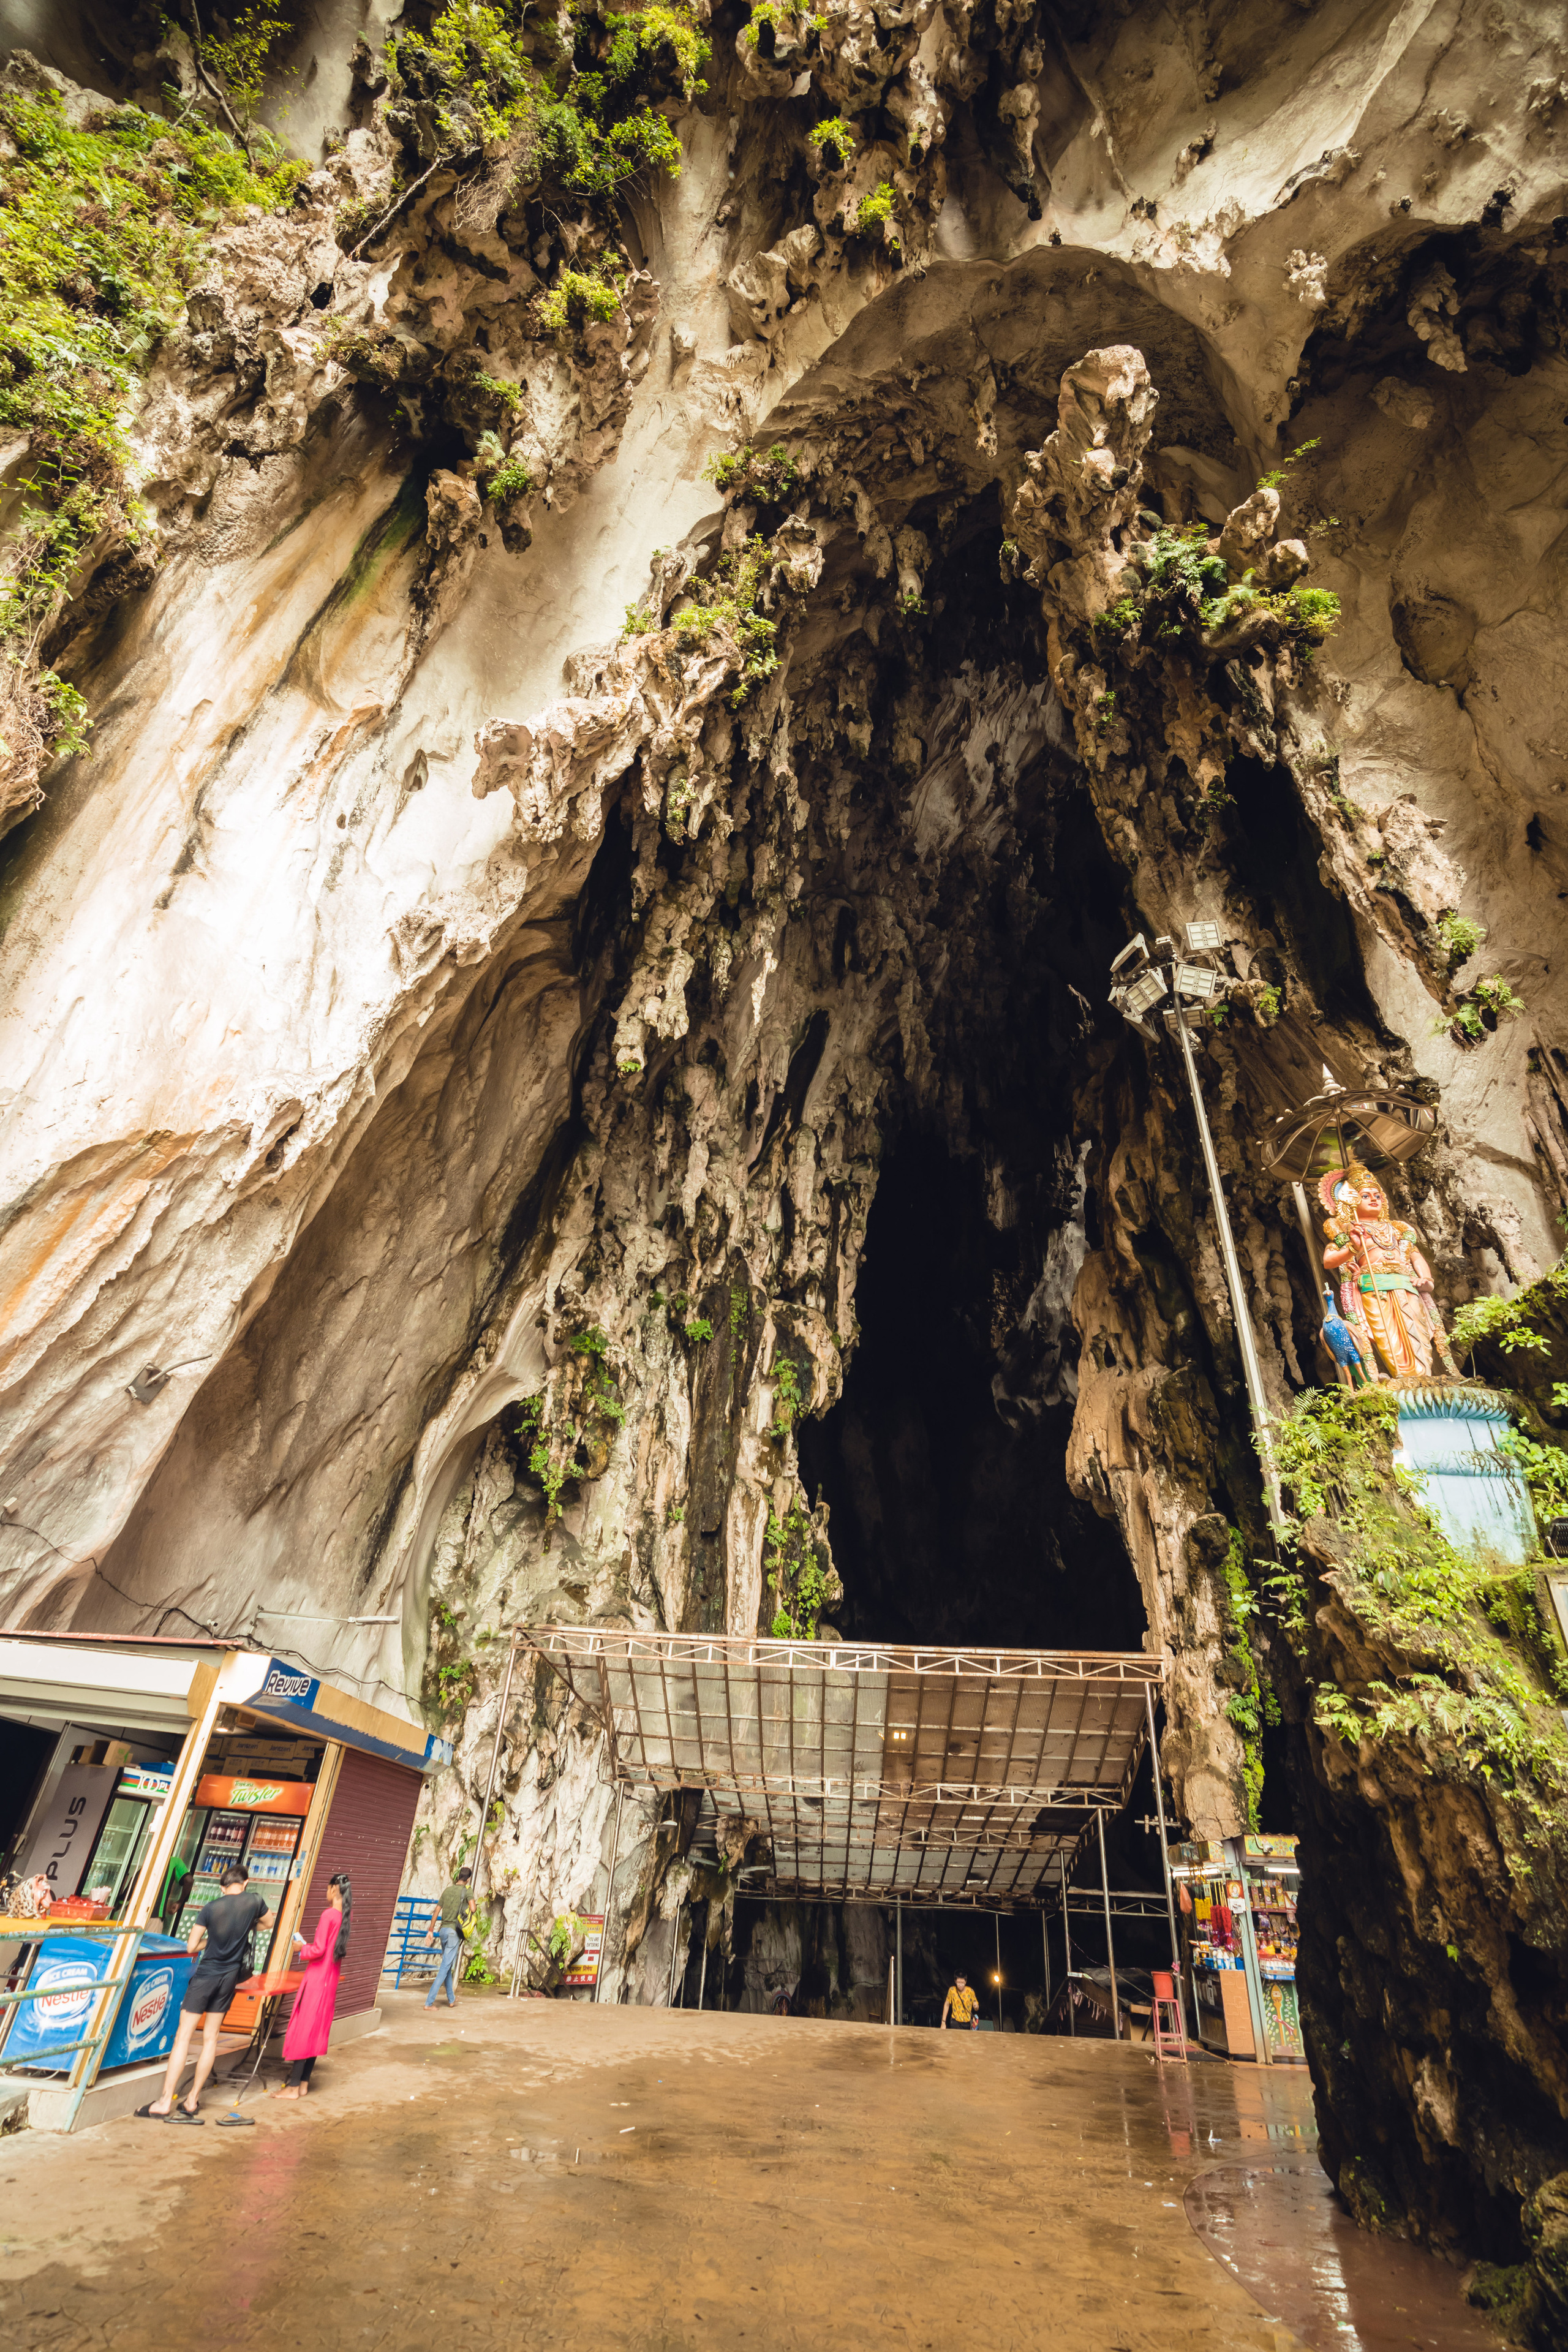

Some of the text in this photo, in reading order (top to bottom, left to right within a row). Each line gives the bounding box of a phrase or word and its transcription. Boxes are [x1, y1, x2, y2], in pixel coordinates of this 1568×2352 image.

[265, 1670, 311, 1696] Revive
[137, 1774, 170, 1793] 100PL
[230, 1786, 281, 1805] Twister
[45, 1796, 86, 1881] PLUS
[50, 1967, 88, 1981] ICE CREAM
[151, 1973, 168, 1988] CREAM
[132, 1991, 167, 2029] Nestlé
